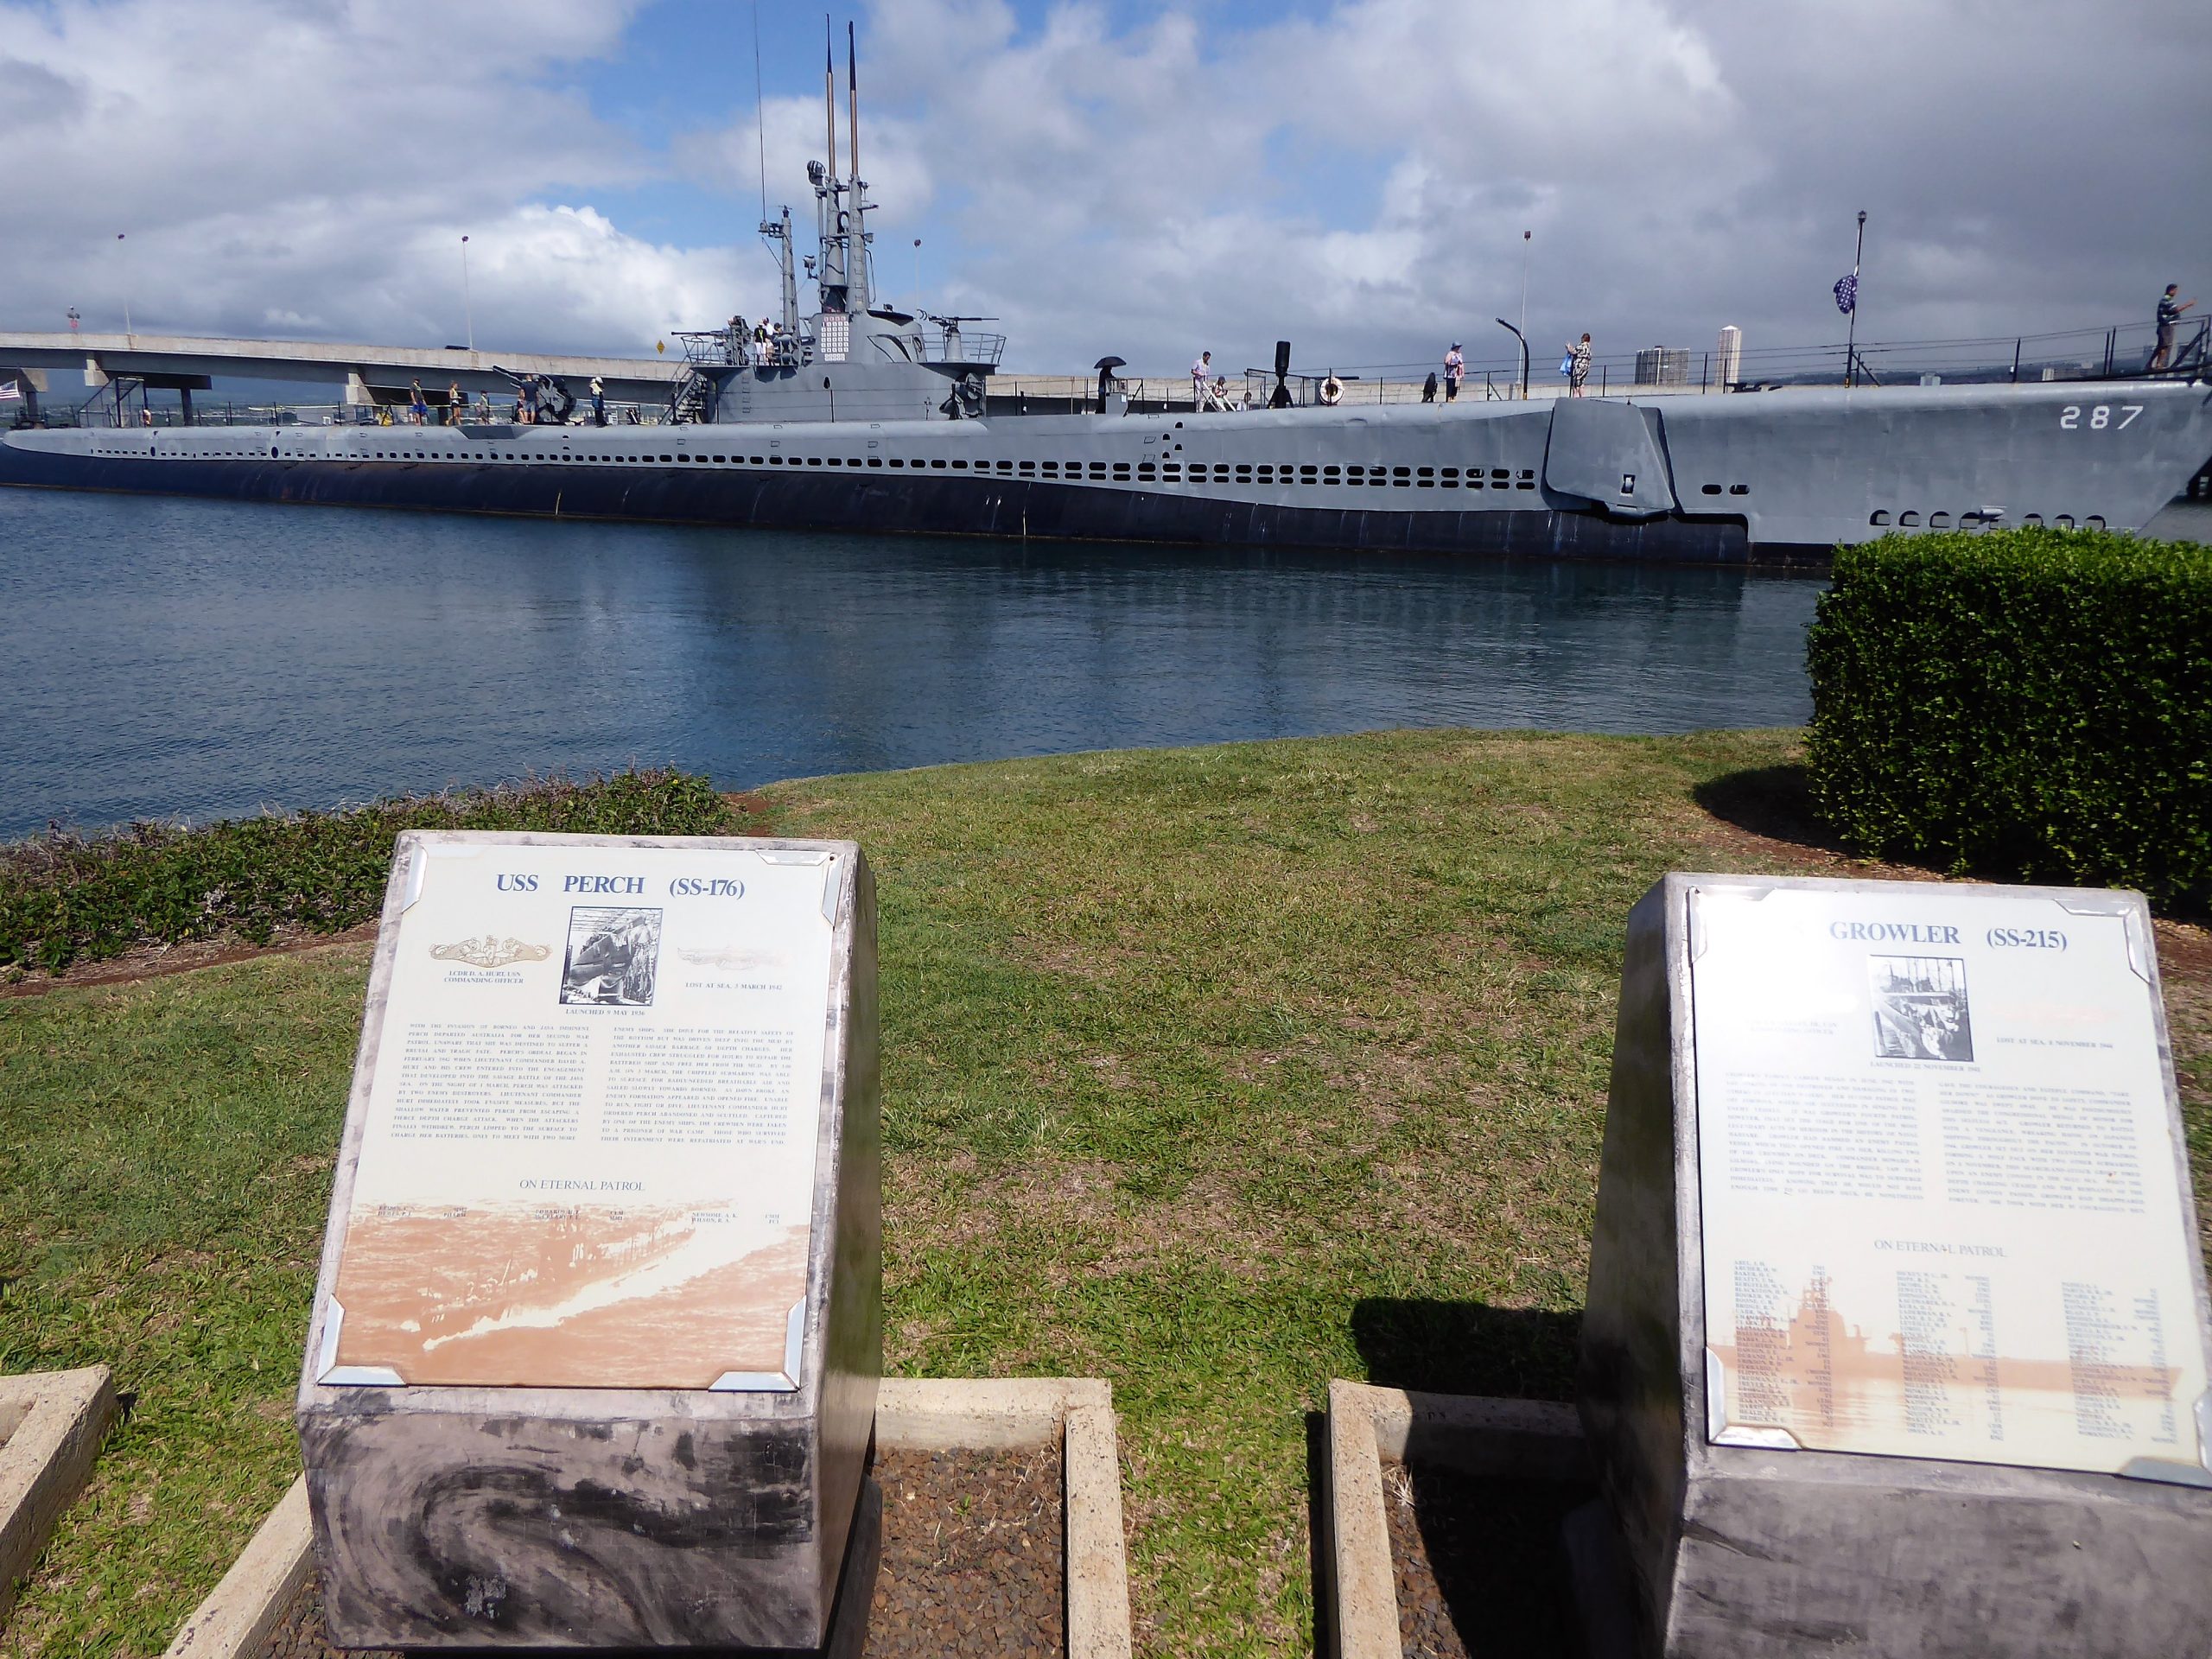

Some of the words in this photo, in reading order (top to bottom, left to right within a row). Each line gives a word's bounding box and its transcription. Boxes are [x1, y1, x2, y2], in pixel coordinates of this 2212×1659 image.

[2060, 405, 2143, 429] 287
[497, 874, 538, 892] USS
[563, 875, 645, 894] PERCH
[670, 878, 745, 899] (SS-176)
[1830, 921, 1961, 944] GROWLER
[1986, 927, 2067, 952] (SS-215)
[519, 1180, 537, 1189] ON
[541, 1180, 597, 1190] ETERNAL
[600, 1181, 645, 1191] PATROL
[1874, 1240, 1893, 1250] ON
[1896, 1241, 1955, 1254] ETERNAL
[1959, 1244, 2005, 1257] PATROL
